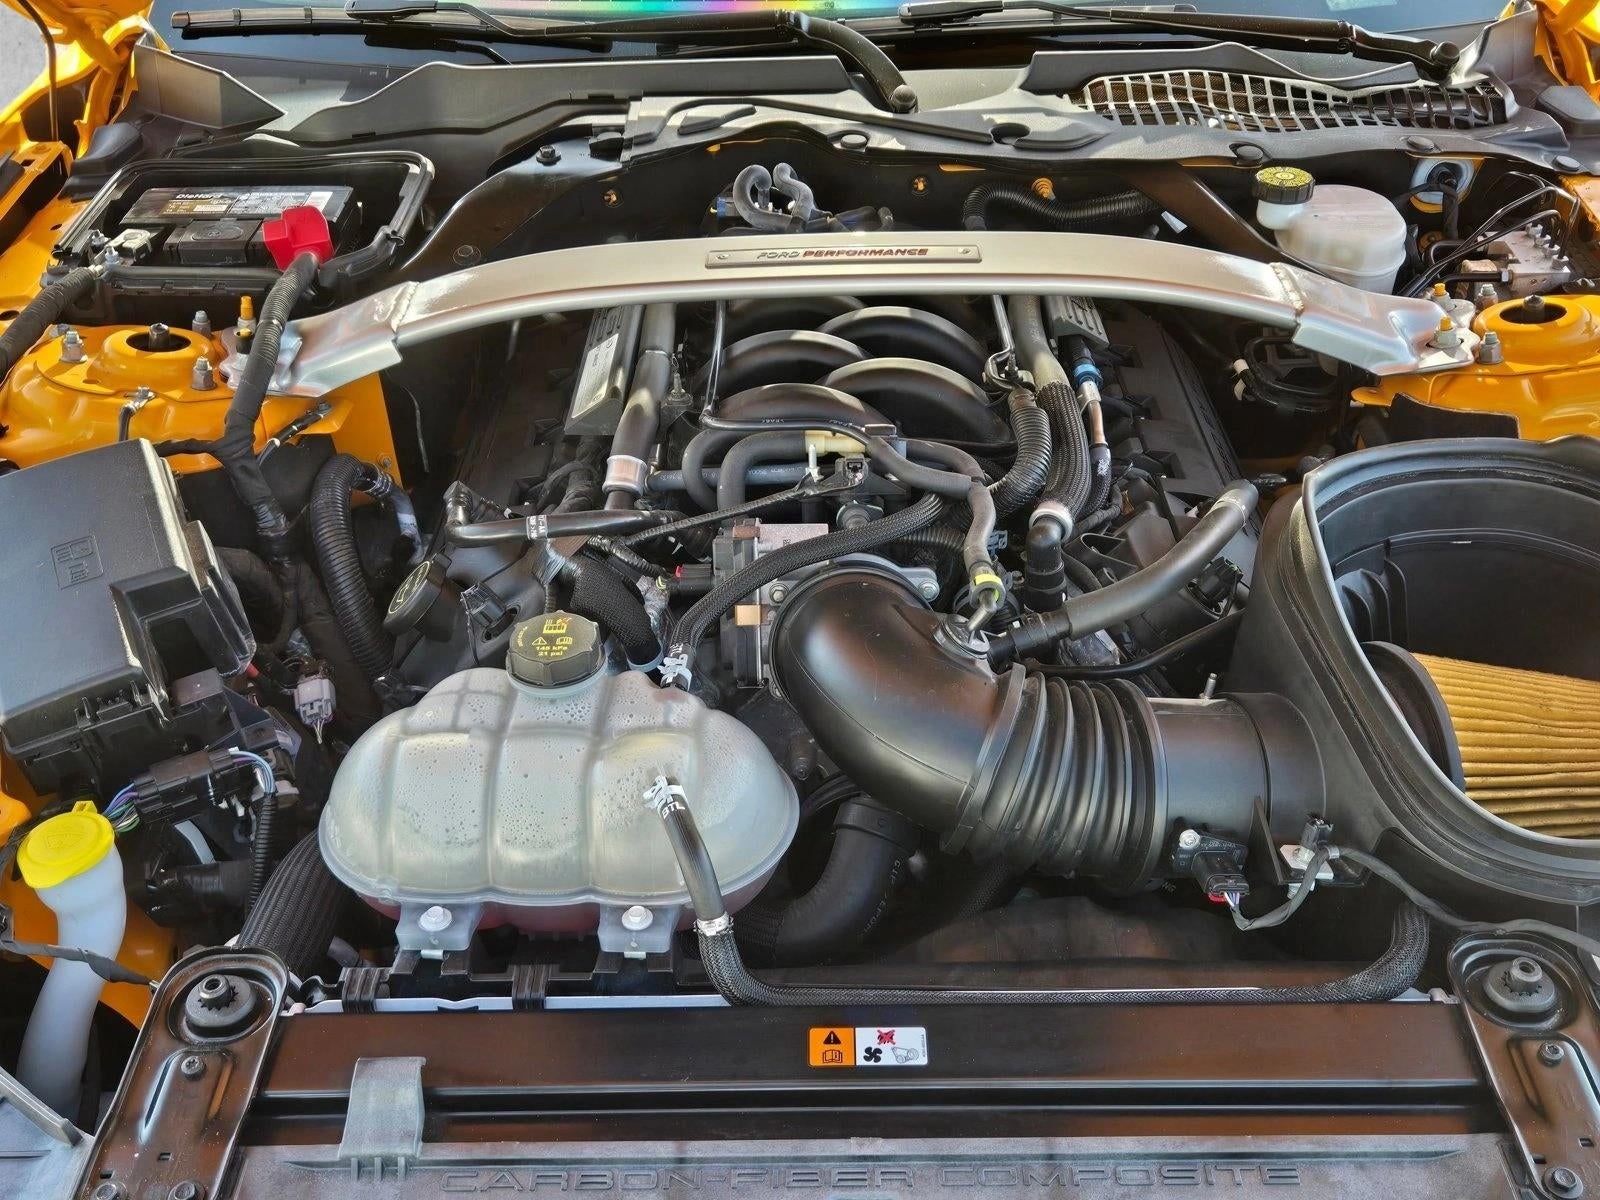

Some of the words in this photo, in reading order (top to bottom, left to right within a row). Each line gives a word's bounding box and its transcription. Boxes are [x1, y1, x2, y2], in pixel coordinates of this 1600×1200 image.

[757, 251, 800, 259] FORD
[802, 248, 929, 258] PERFORMANCE
[661, 801, 686, 820] BTL
[440, 1166, 914, 1192] CARBON-FIBER
[938, 1164, 1301, 1187] COMPOSITE
